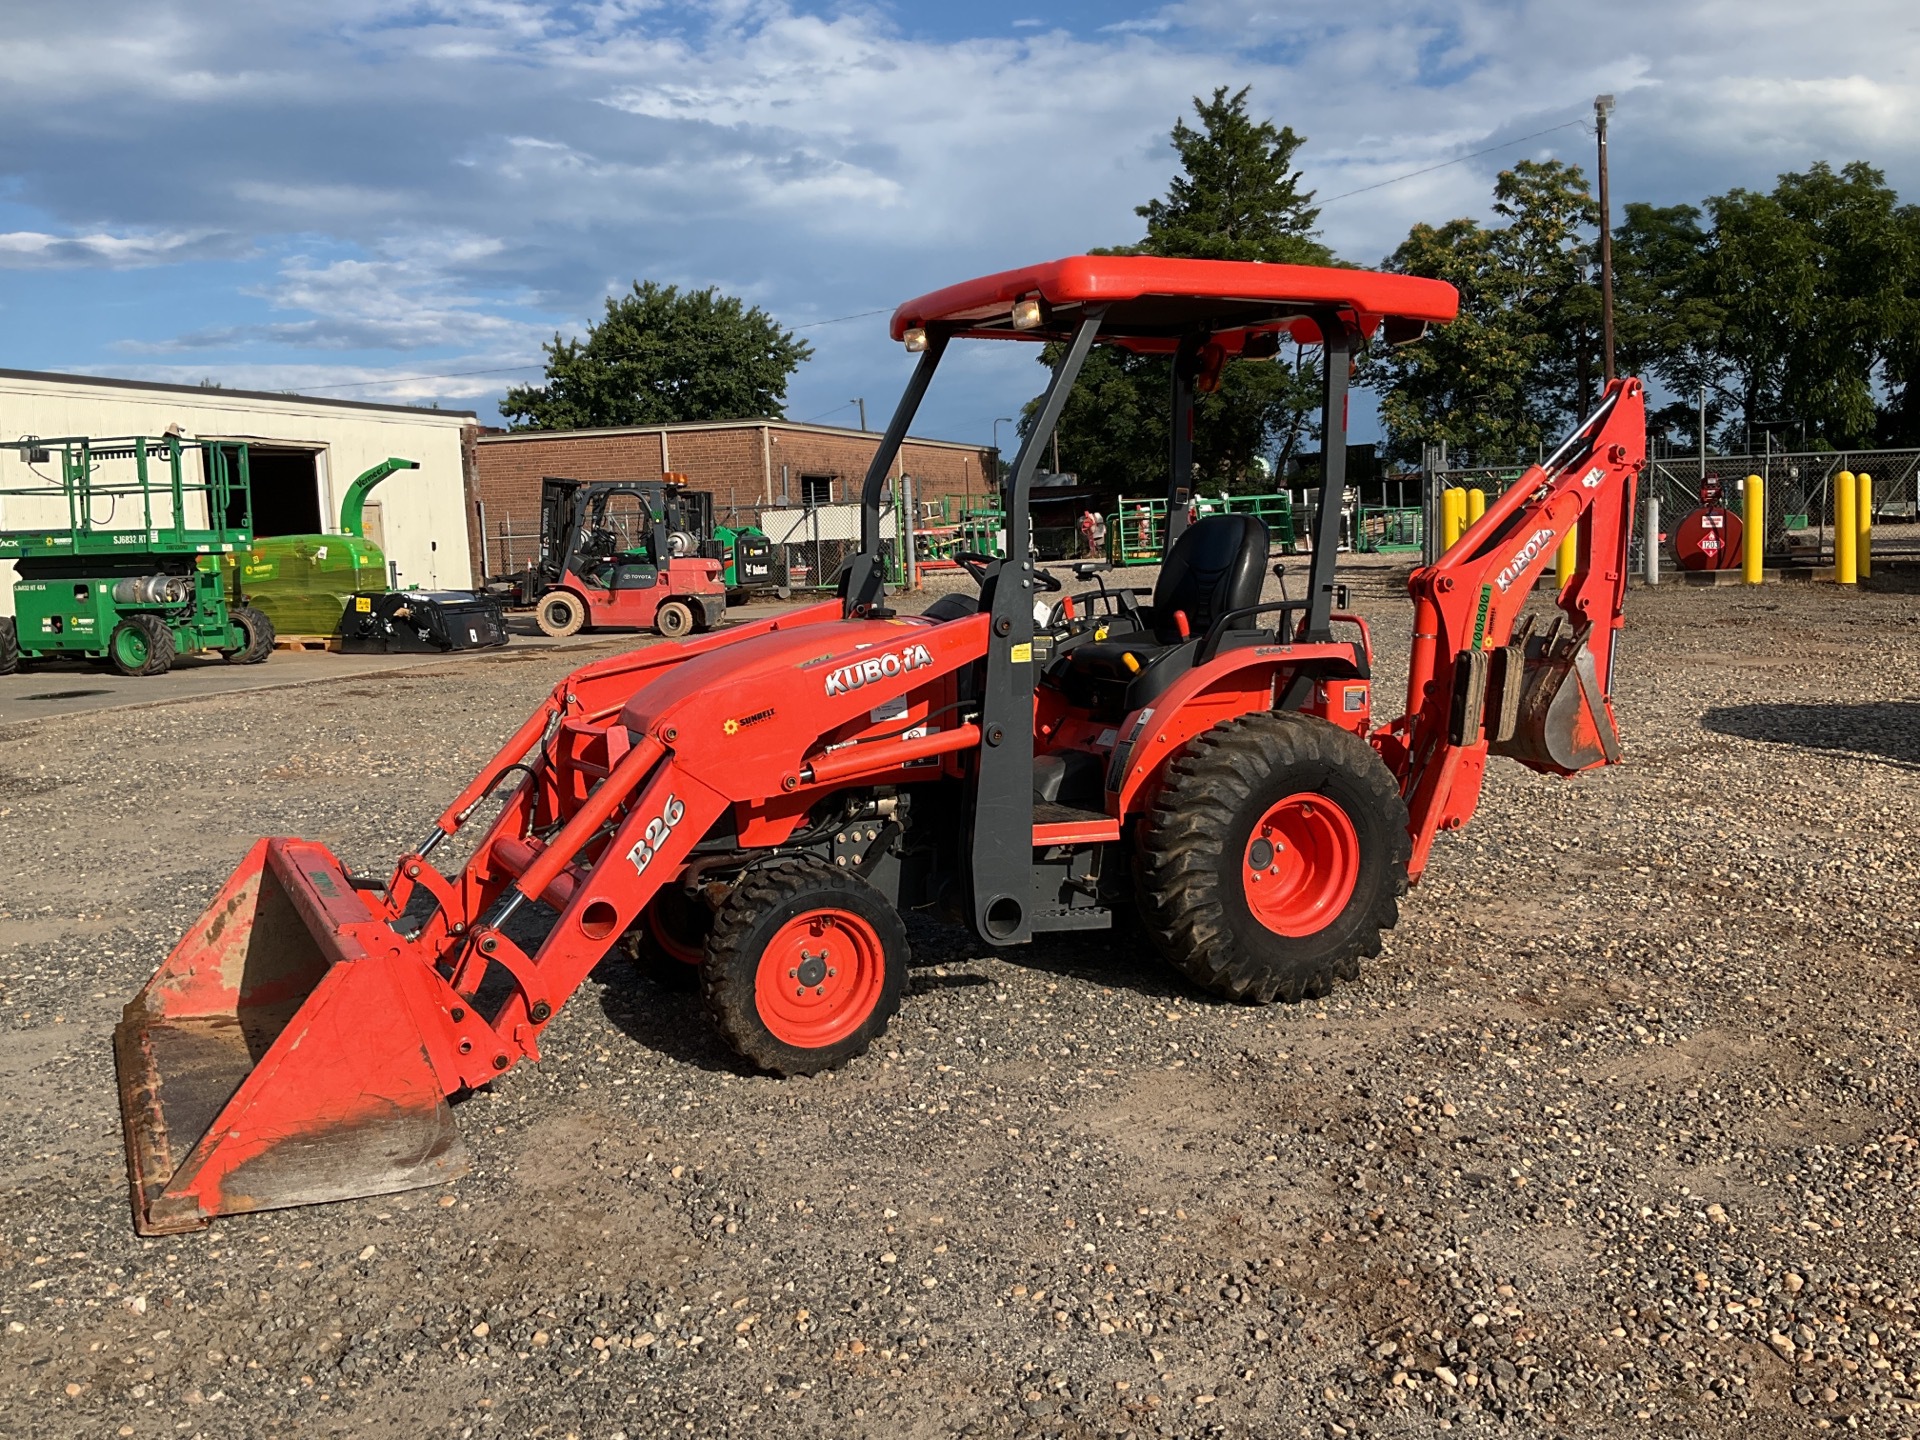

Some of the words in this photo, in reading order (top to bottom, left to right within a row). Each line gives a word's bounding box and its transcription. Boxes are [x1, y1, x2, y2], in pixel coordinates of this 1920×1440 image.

[355, 467, 384, 488] Vermeer
[0, 538, 19, 547] ACK
[1703, 541, 1720, 549] 1203
[752, 564, 768, 575] Bobcat
[1495, 528, 1557, 595] KUBOTA
[1472, 586, 1491, 650] 7008001
[825, 644, 934, 697] KUBOTA
[739, 708, 775, 726] SUNBELT
[625, 793, 685, 876] B26
